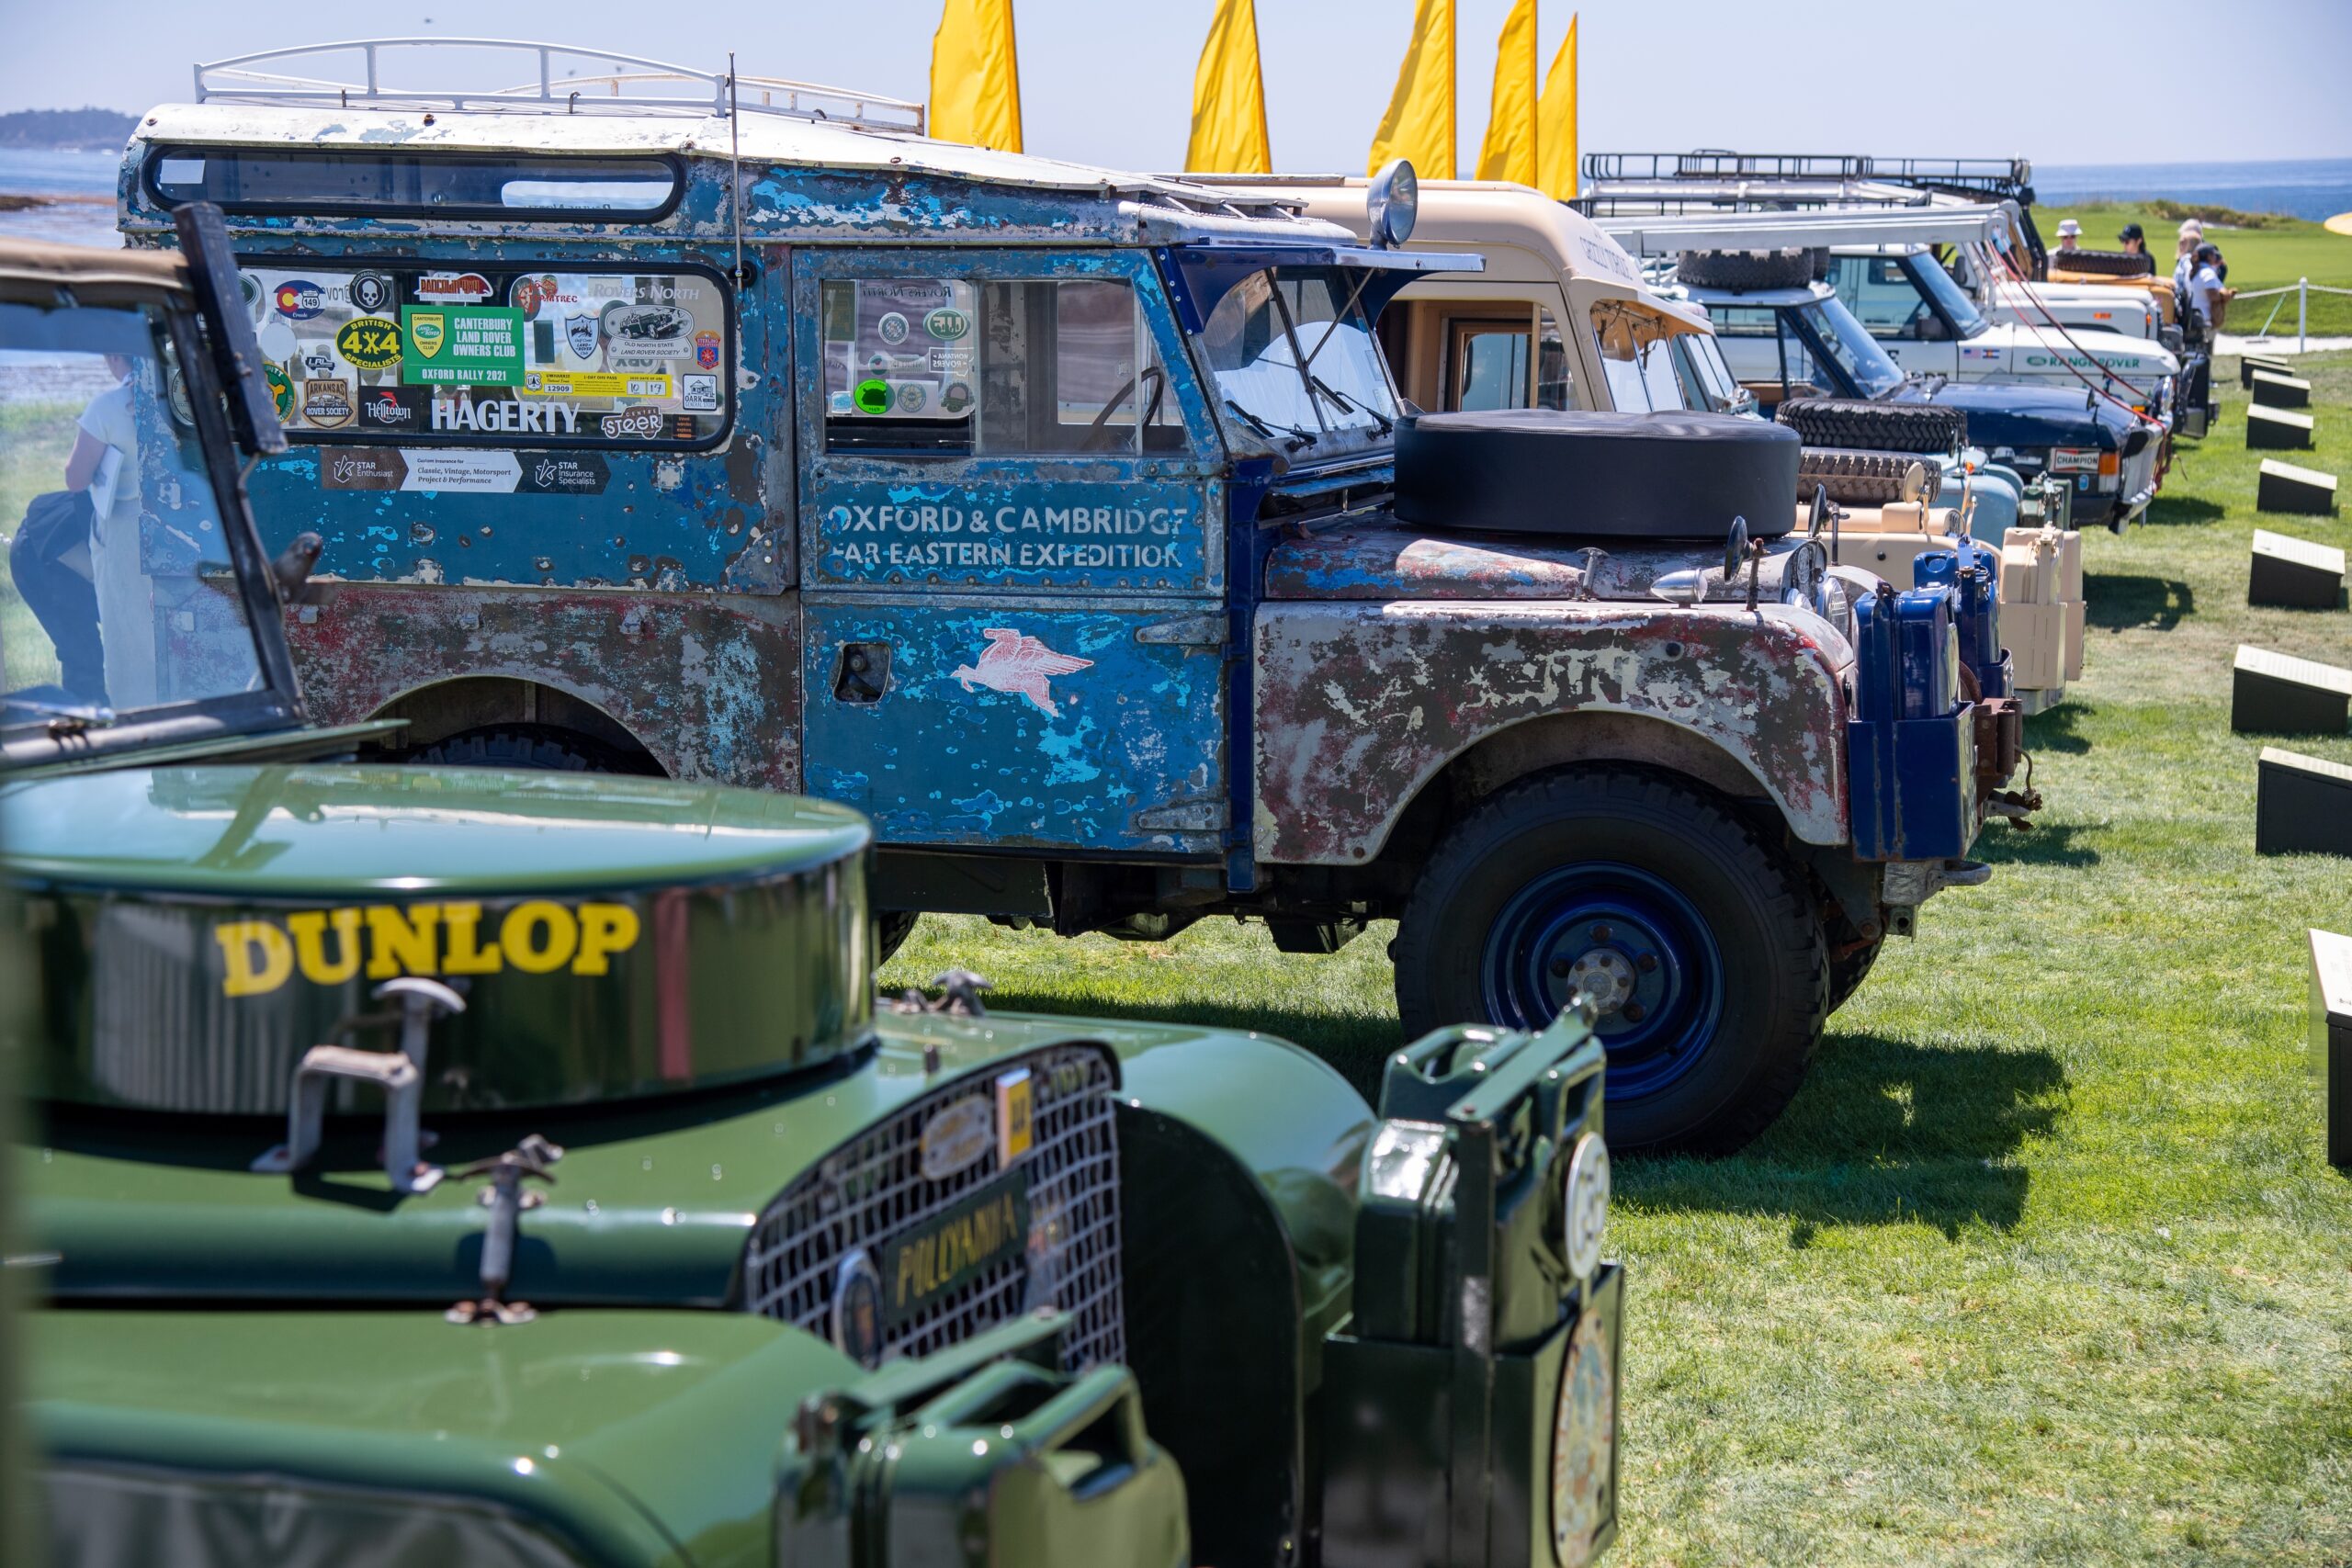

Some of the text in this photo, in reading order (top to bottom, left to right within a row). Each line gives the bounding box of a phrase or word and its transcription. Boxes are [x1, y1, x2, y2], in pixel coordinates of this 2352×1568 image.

[304, 298, 318, 307] 149
[349, 320, 391, 331] BRITISH
[454, 317, 514, 331] CANTERBURY
[456, 332, 512, 344] LAND ROVER
[453, 344, 516, 357] OWNERS CLUB
[344, 353, 401, 368] SPECIALISTS
[422, 368, 507, 381] OXFORD RALLY 2021
[309, 383, 345, 397] ARKANSAS
[306, 407, 349, 416] ROVER SOCIETY
[365, 402, 412, 419] Helltown
[356, 461, 376, 469] STAR
[558, 461, 578, 469] STAR
[2056, 456, 2098, 465] CHAMPION
[356, 469, 393, 478] Enthusiast
[417, 467, 511, 477] Classic, Vintage, Motorsport
[558, 469, 594, 478] Insurance
[417, 476, 442, 484] Project
[448, 476, 492, 485] Performance
[558, 477, 596, 486] Specialists
[827, 505, 963, 533] OXFORD
[968, 509, 990, 533] &
[889, 542, 1011, 566] EASTERN
[215, 899, 639, 998] DUNLOP
